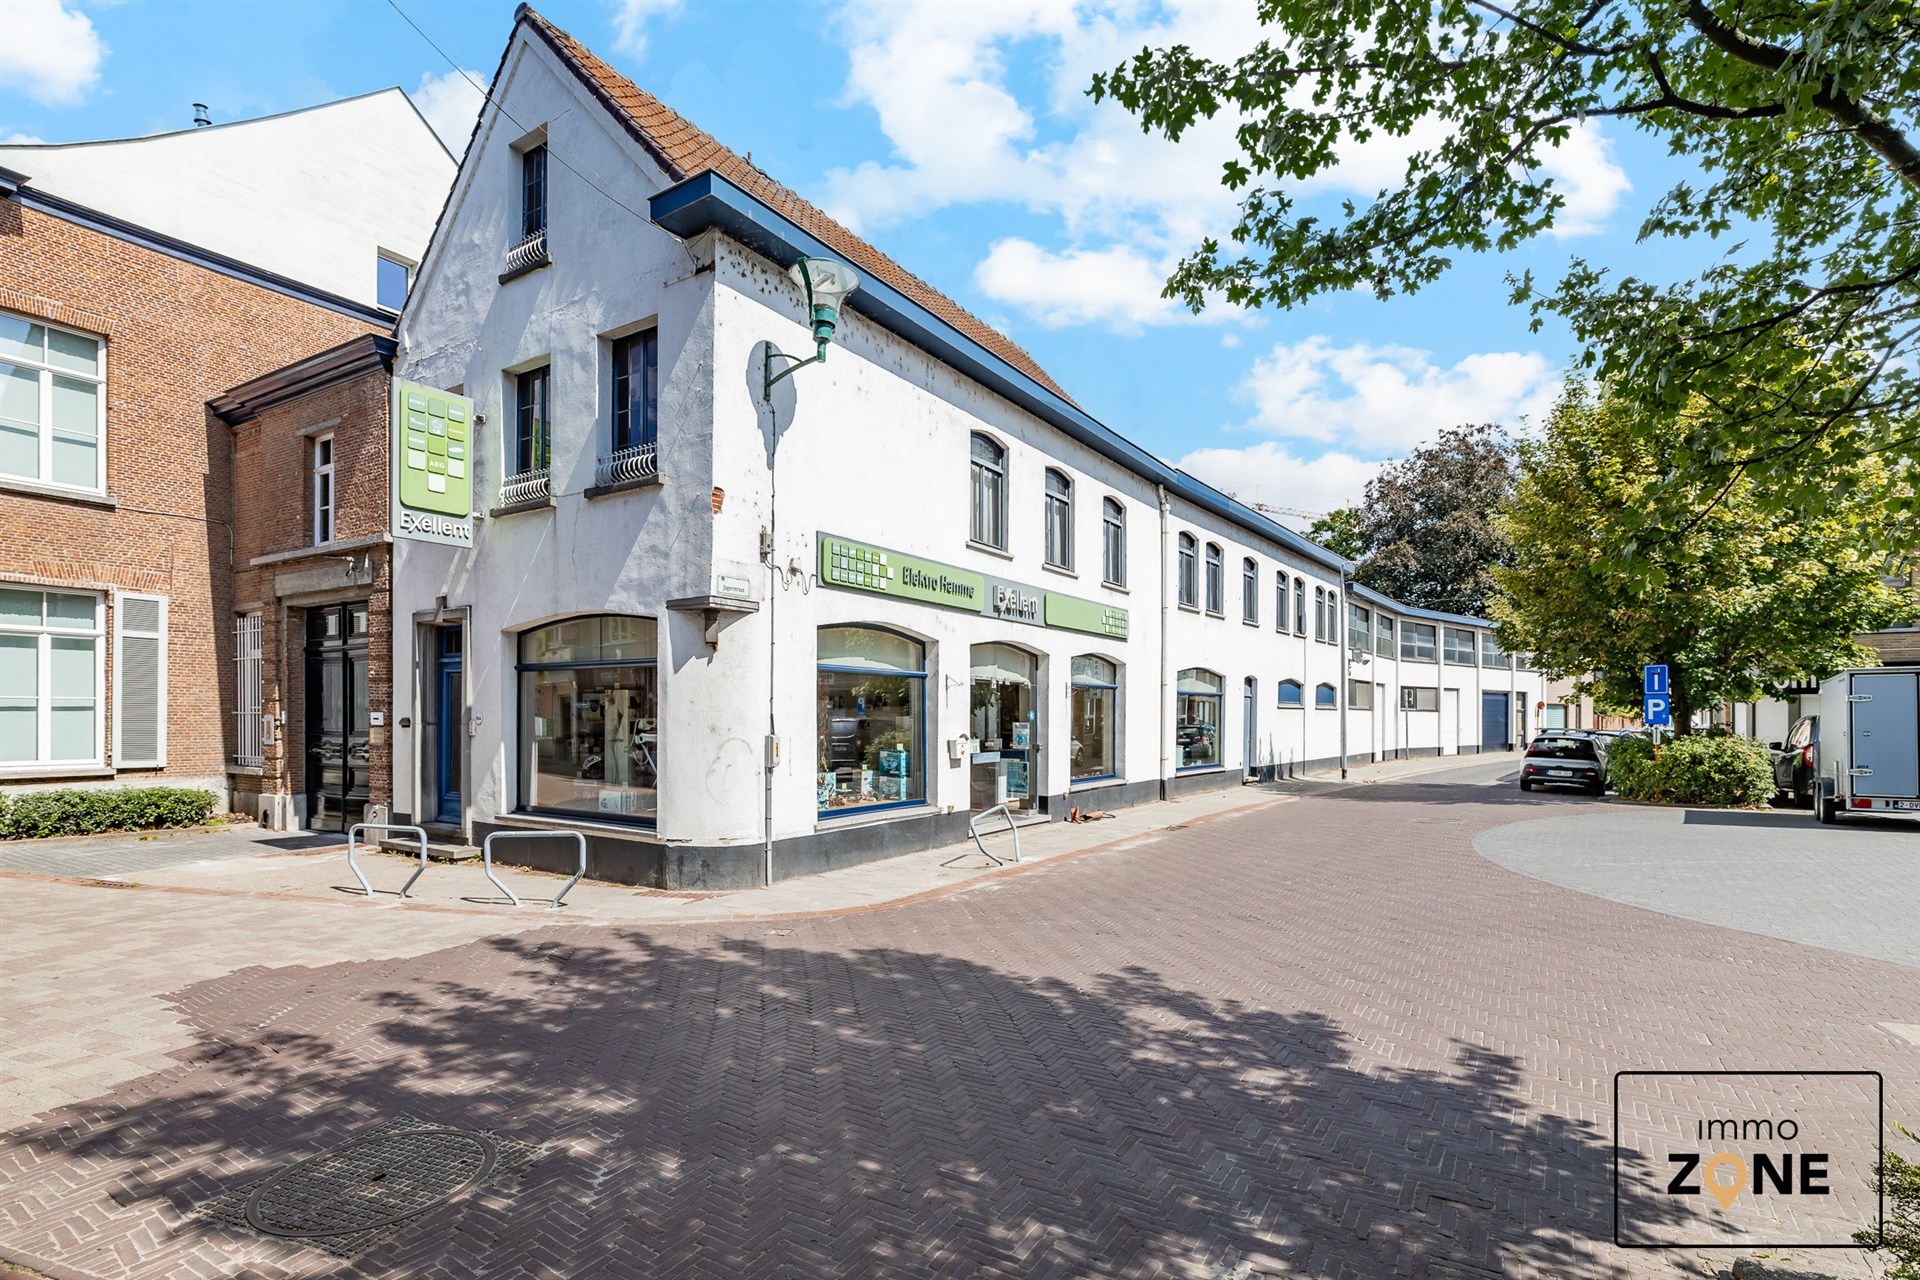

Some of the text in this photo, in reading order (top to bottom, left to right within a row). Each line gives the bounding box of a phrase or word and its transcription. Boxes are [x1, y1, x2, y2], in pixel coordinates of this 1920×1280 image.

[429, 460, 445, 469] AEG
[401, 511, 470, 538] Exellent
[902, 565, 938, 592] Elektro
[993, 585, 1038, 614] Exellent
[1648, 699, 1666, 720] P
